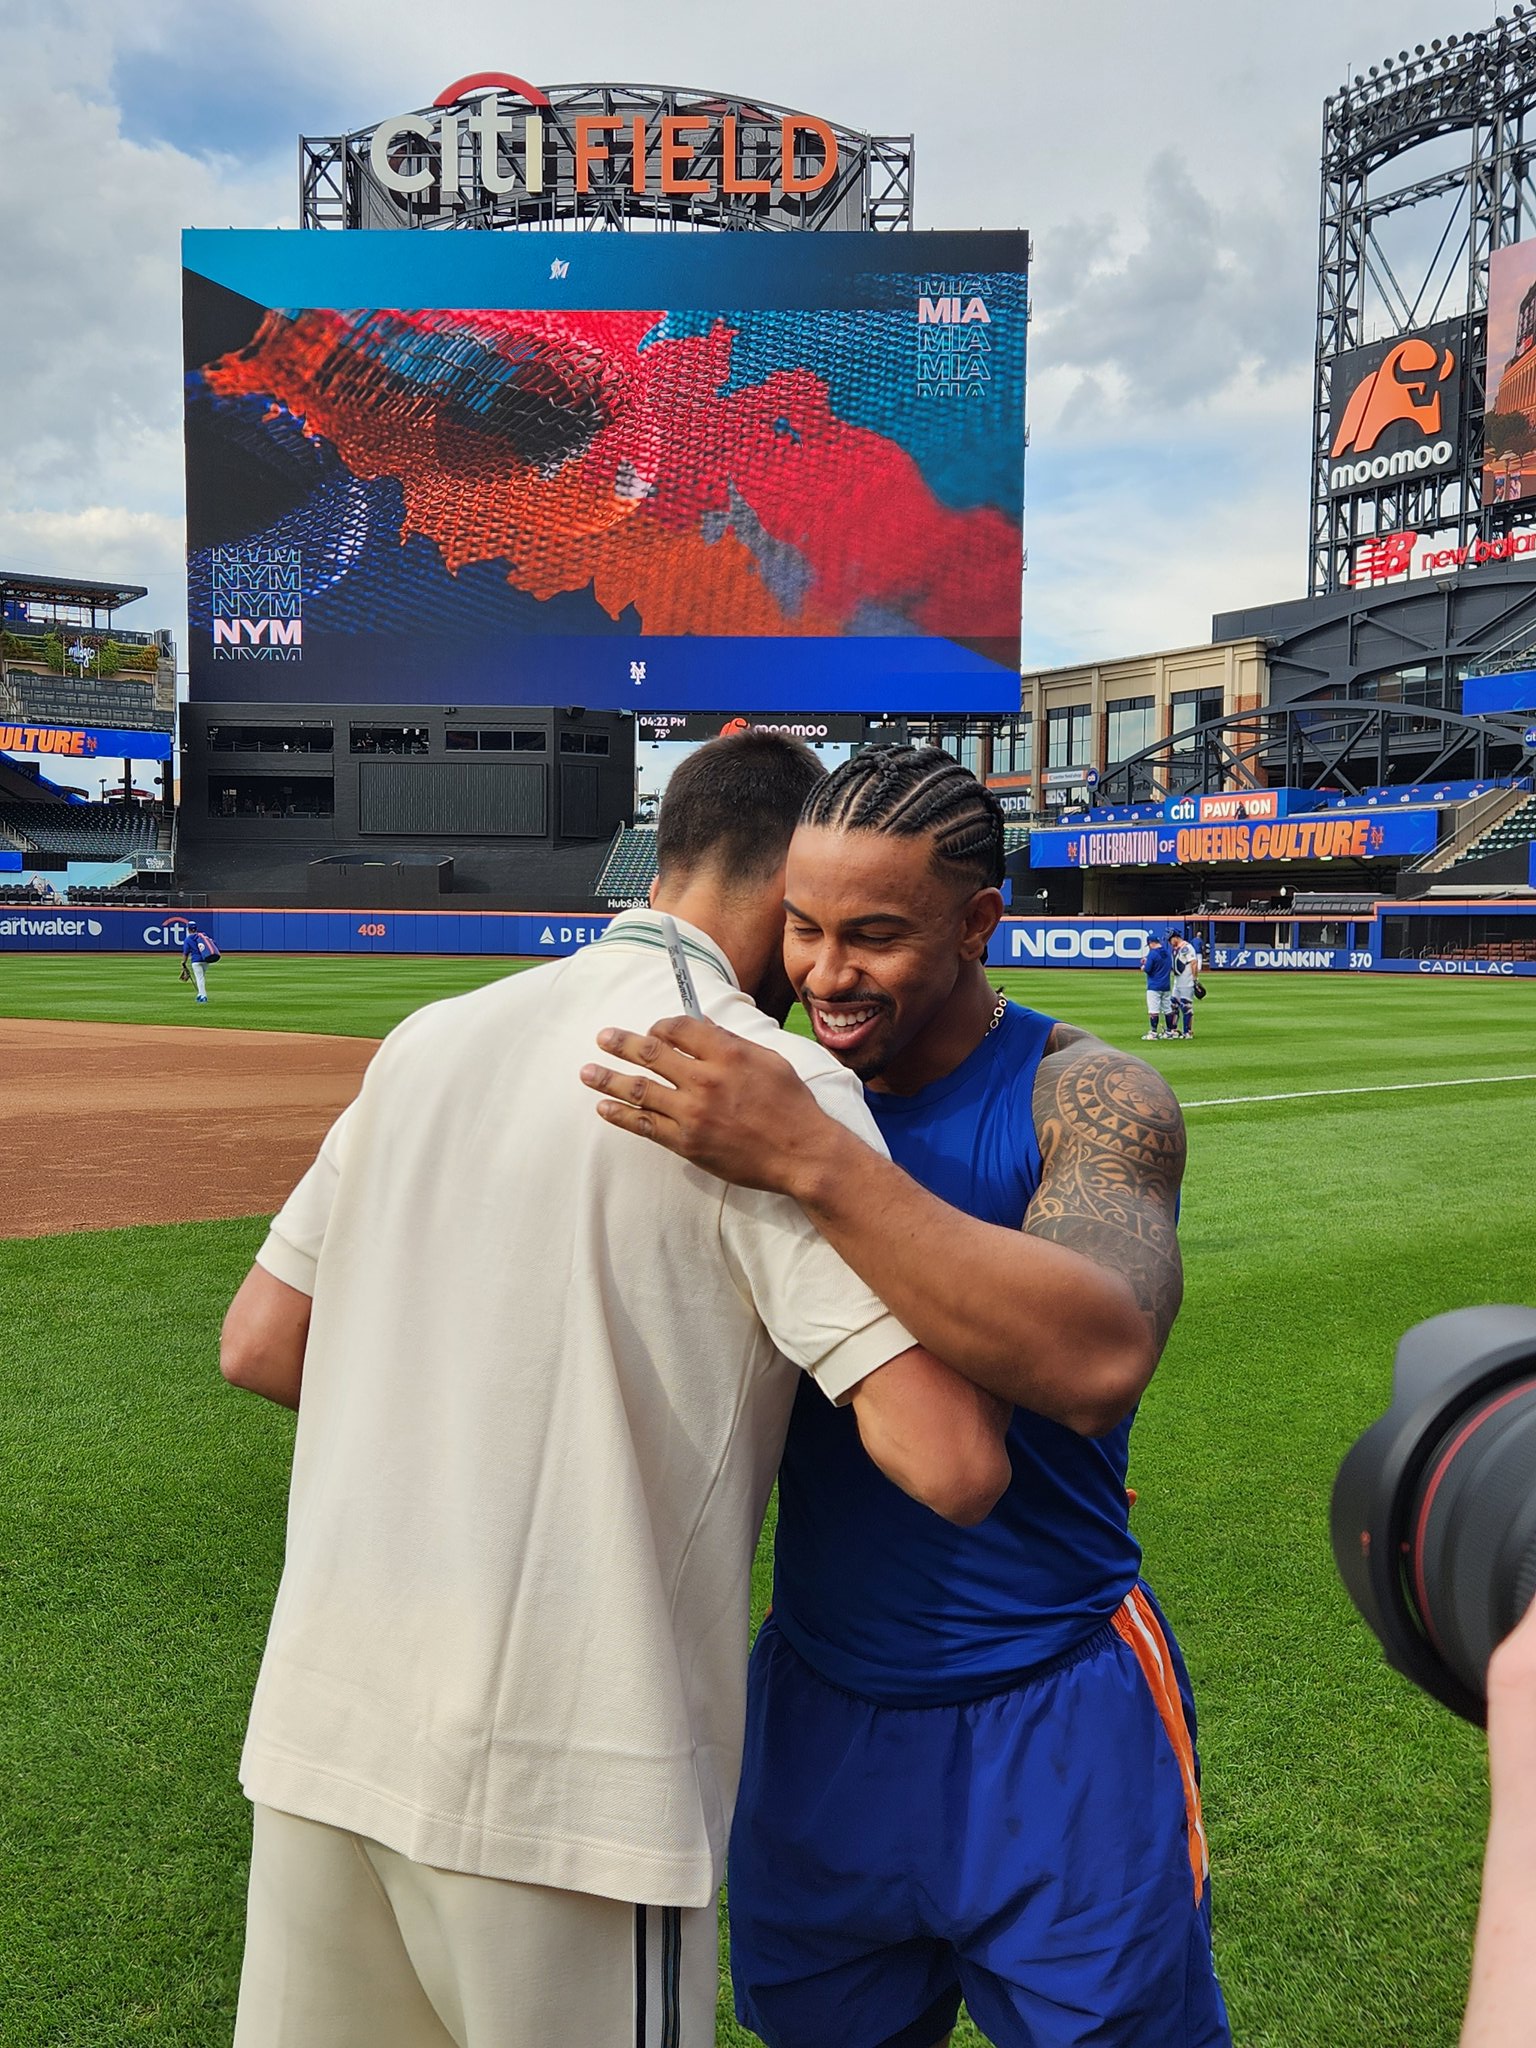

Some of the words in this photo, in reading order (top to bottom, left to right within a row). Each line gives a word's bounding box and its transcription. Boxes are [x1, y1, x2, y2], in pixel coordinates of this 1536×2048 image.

[371, 94, 543, 194] citi
[576, 115, 839, 194] FIELD
[919, 297, 992, 324] MIA
[919, 325, 992, 352] MIA
[918, 353, 992, 380] MIA
[1331, 440, 1453, 490] moomoo
[1422, 545, 1470, 572] new
[212, 563, 302, 590] NYM
[213, 591, 302, 617] NYM
[213, 619, 302, 645] NYM
[640, 716, 669, 727] 04:22
[670, 717, 686, 727] PM
[0, 726, 86, 754] ULTURE
[1170, 801, 1195, 820] citi
[1079, 834, 1087, 864] A
[1089, 831, 1157, 864] CELEBRATION
[1159, 840, 1176, 853] OF
[1176, 826, 1250, 863] QUEENS
[1251, 820, 1371, 860] CULTURE
[607, 897, 650, 908] HubSpot
[357, 923, 386, 936] 408
[560, 927, 607, 943] DEL
[1012, 929, 1150, 958] NOCO
[1254, 951, 1335, 968] DUNKIN'
[1349, 952, 1373, 969] 370
[1419, 960, 1514, 975] CADILLAC
